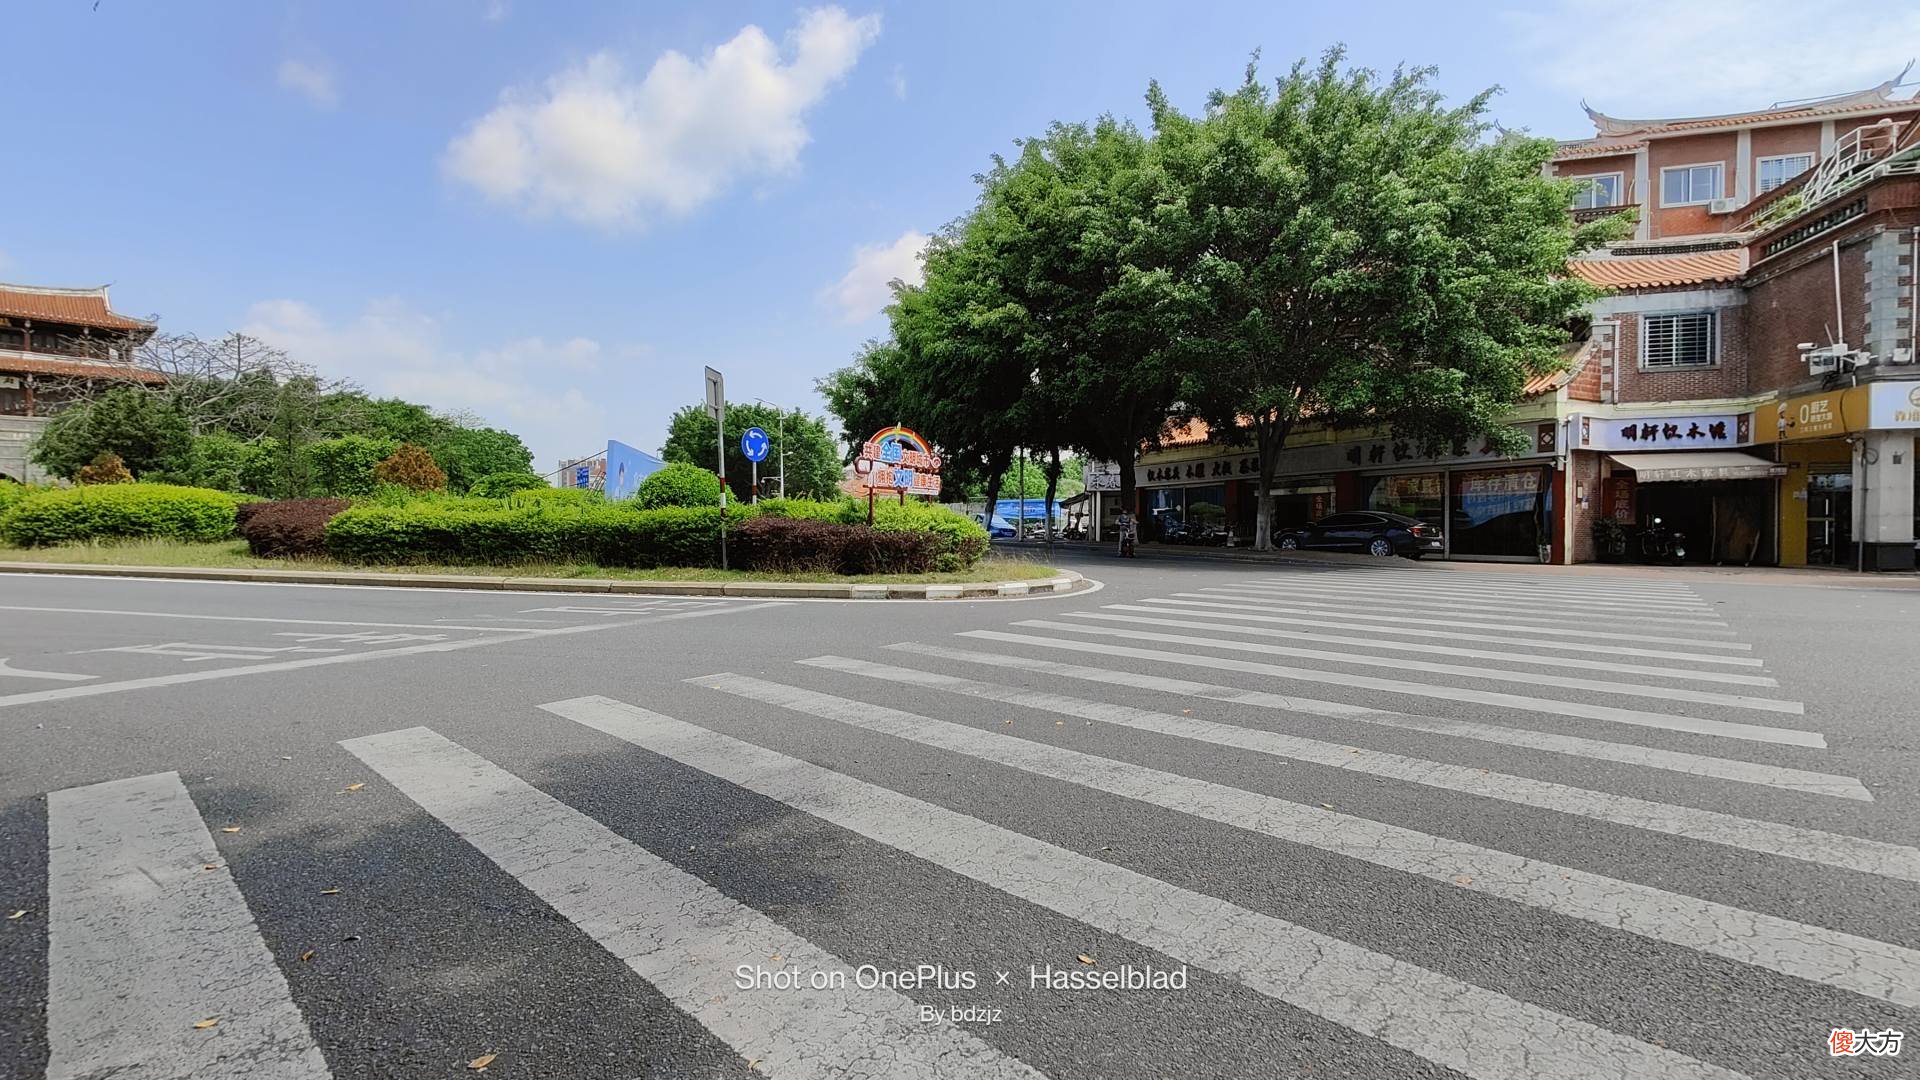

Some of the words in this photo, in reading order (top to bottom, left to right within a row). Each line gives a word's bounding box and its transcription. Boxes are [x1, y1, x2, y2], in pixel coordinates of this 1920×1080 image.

[863, 441, 931, 468] 共建全国文明城市
[1470, 471, 1537, 492] 库存清仓
[1640, 467, 1728, 479] 明轩红木家具
